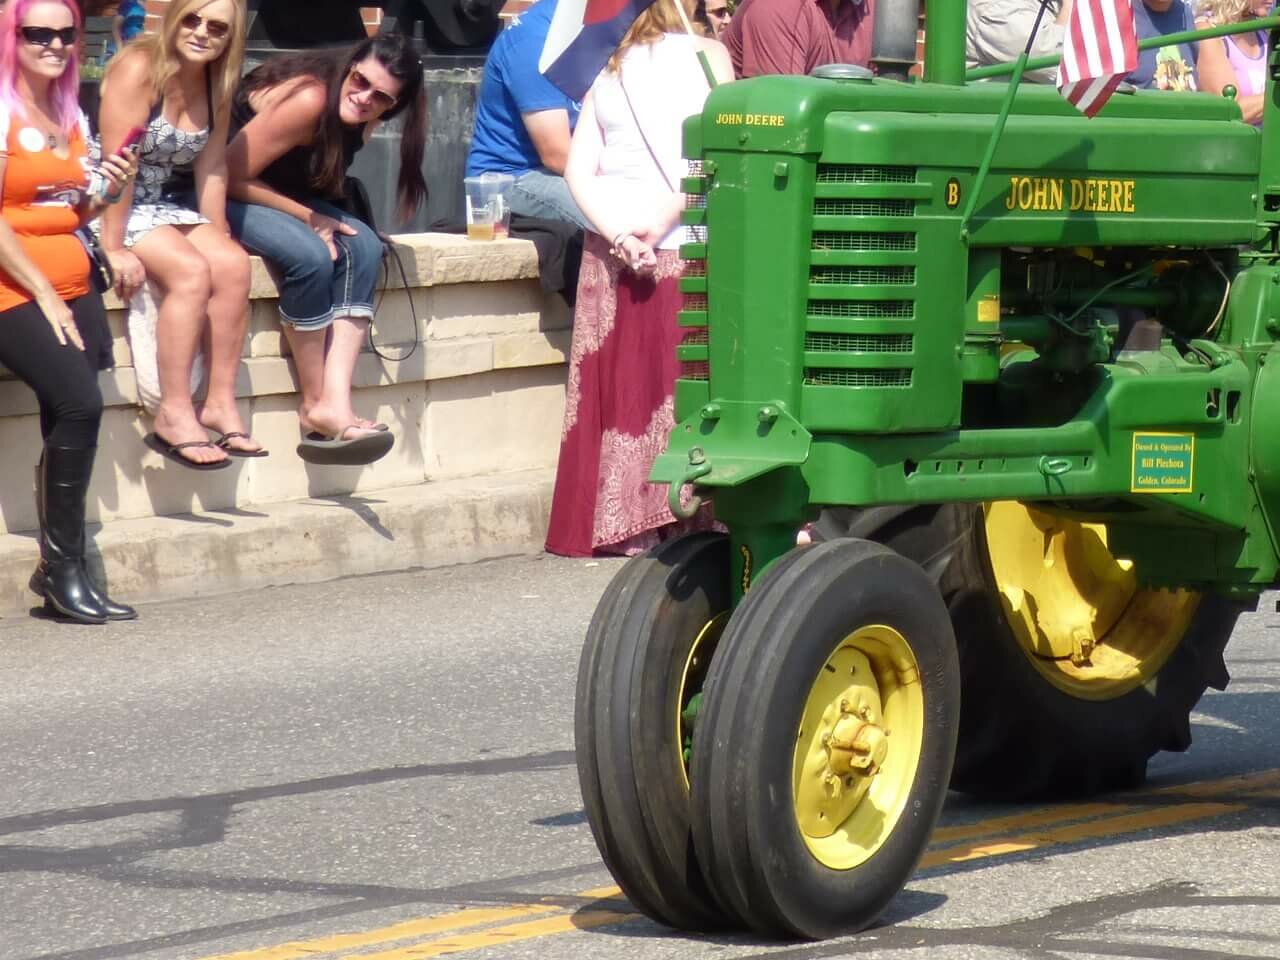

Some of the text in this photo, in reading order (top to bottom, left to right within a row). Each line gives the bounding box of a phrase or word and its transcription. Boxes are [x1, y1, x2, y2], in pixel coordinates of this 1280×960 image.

[716, 113, 785, 127] JOHN DEERE
[947, 182, 958, 206] B
[1006, 176, 1136, 213] JOHN DEERE
[1142, 457, 1154, 469] Bill
